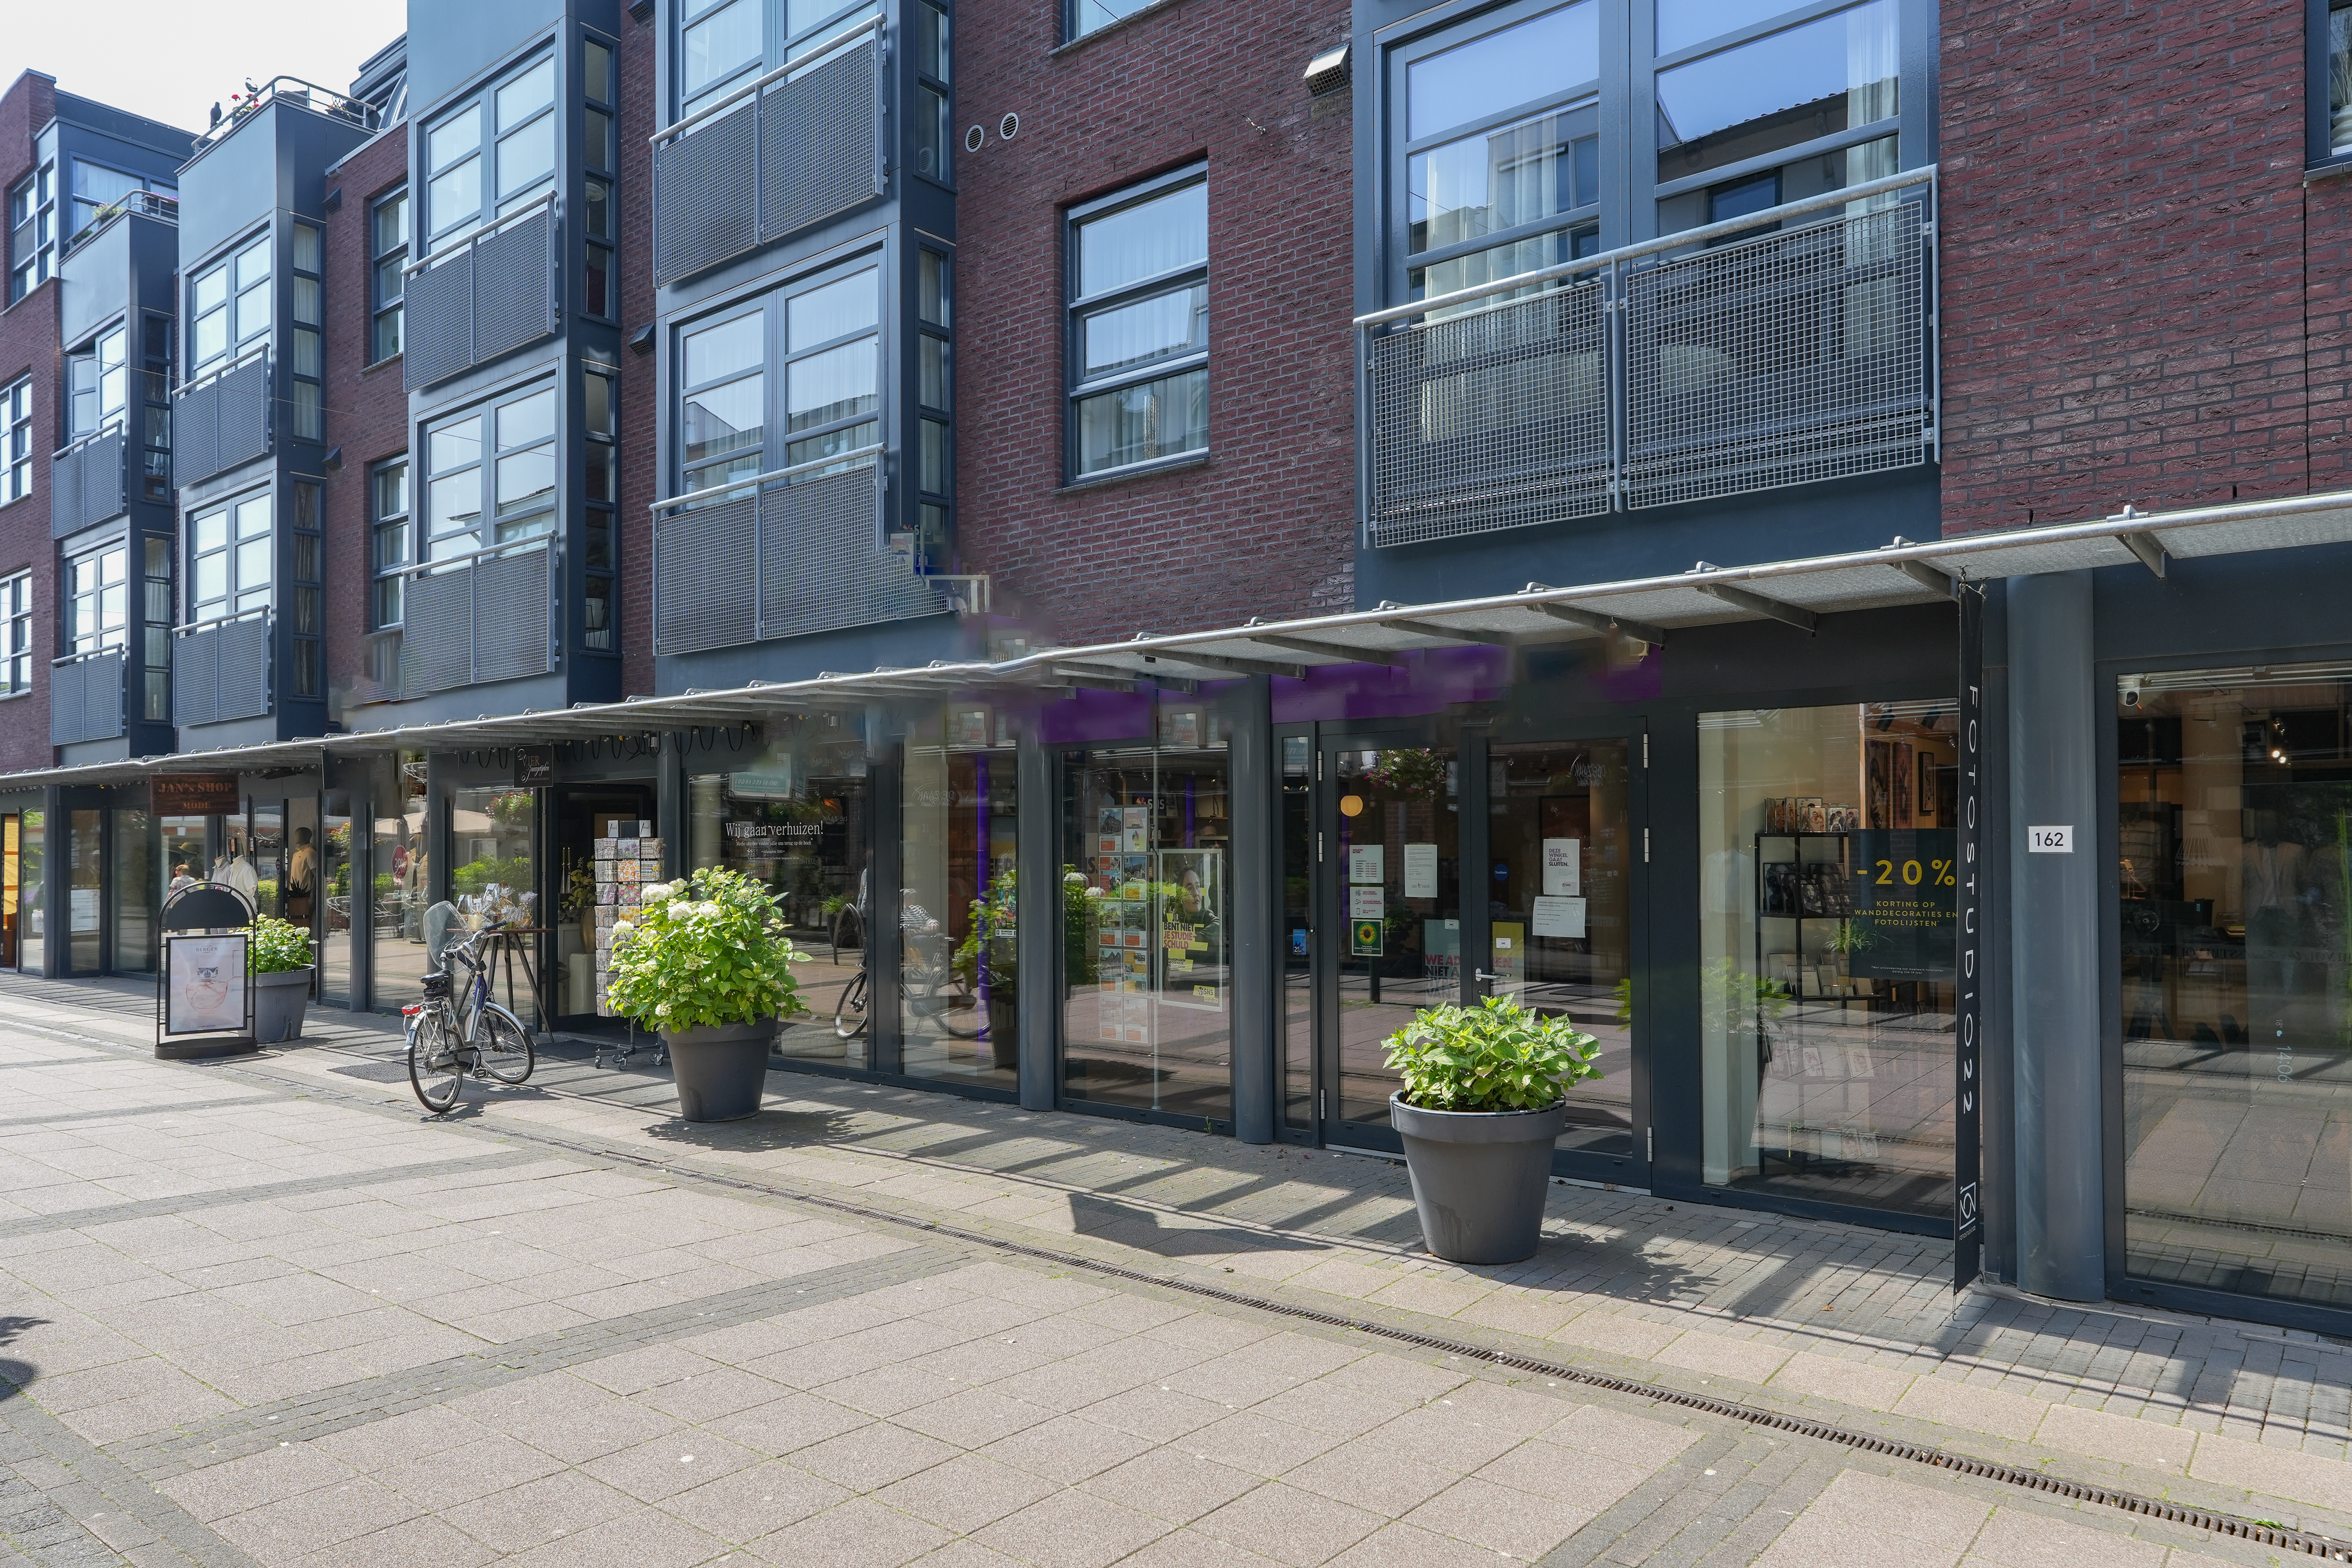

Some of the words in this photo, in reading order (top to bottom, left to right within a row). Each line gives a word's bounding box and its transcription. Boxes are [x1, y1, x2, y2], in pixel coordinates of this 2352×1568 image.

[522, 756, 540, 766] VIER
[198, 783, 232, 792] SHOP
[725, 823, 740, 838] Wij
[744, 826, 767, 838] gaan
[770, 820, 823, 835] verhuizen!
[2035, 832, 2064, 846] 162
[394, 858, 407, 868] 20%
[1857, 859, 1955, 886] -20%
[1172, 913, 1180, 922] JIJ
[1854, 909, 1941, 917] WANDDECORATIES
[1163, 922, 1180, 931] BENT
[1181, 923, 1194, 932] NIET
[1163, 931, 1170, 939] JE
[1171, 931, 1196, 941] STUDIE-
[1163, 939, 1189, 950] SCHULD
[1425, 954, 1444, 965] WE
[1425, 966, 1449, 977] NIET
[2276, 1046, 2293, 1083] 14:06
